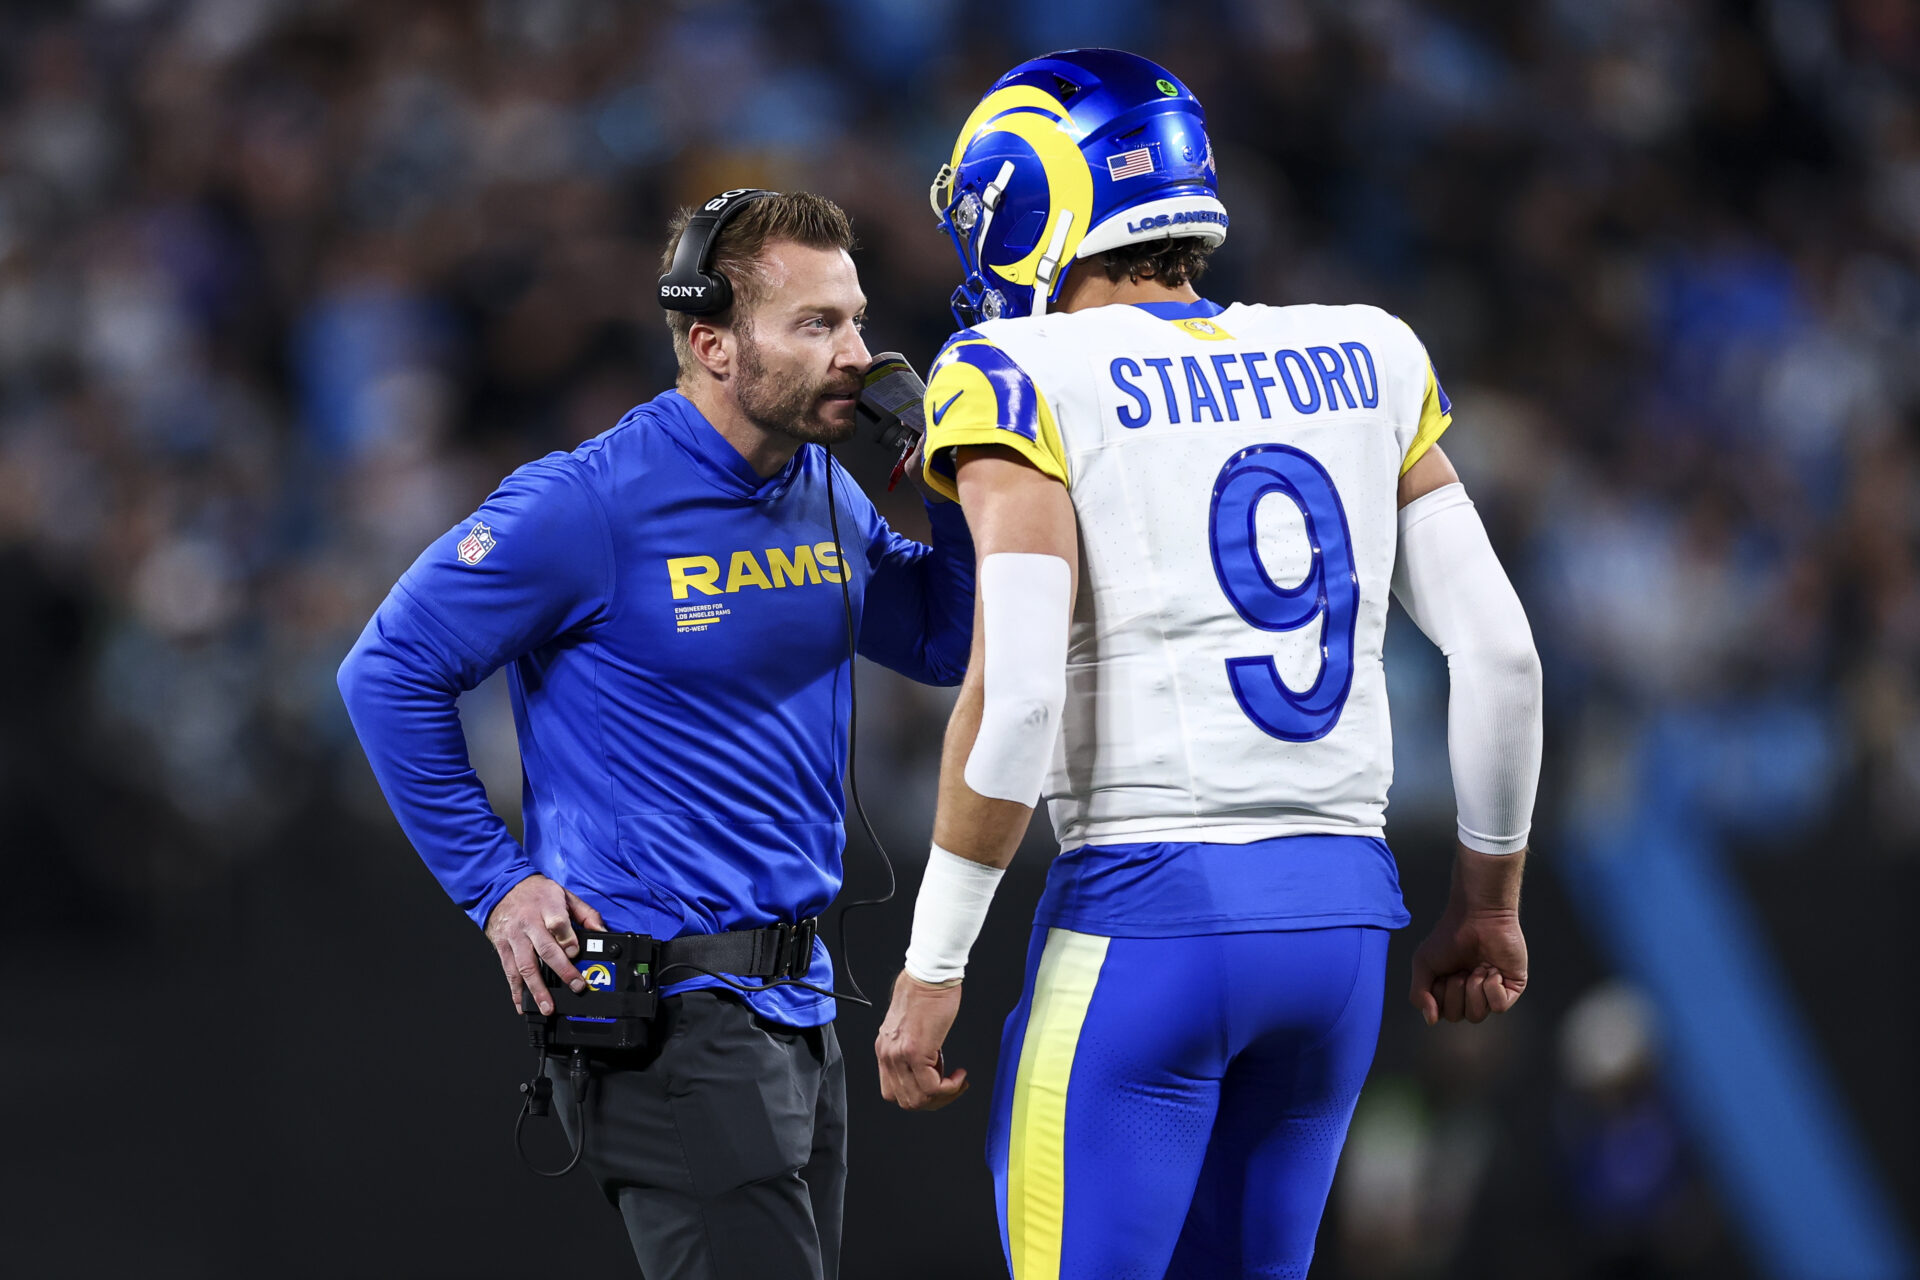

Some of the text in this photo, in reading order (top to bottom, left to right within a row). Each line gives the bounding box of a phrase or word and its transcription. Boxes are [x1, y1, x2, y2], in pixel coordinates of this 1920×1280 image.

[704, 188, 756, 211] SO
[1127, 214, 1170, 233] LOS
[661, 285, 706, 298] SONY
[1110, 341, 1379, 429] STAFFORD
[462, 536, 482, 561] NFL
[667, 542, 852, 599] RAMS
[1208, 443, 1360, 743] 9
[674, 602, 723, 613] ENGINEERED FOR
[688, 610, 715, 619] ANGELES
[715, 608, 731, 616] RAMS
